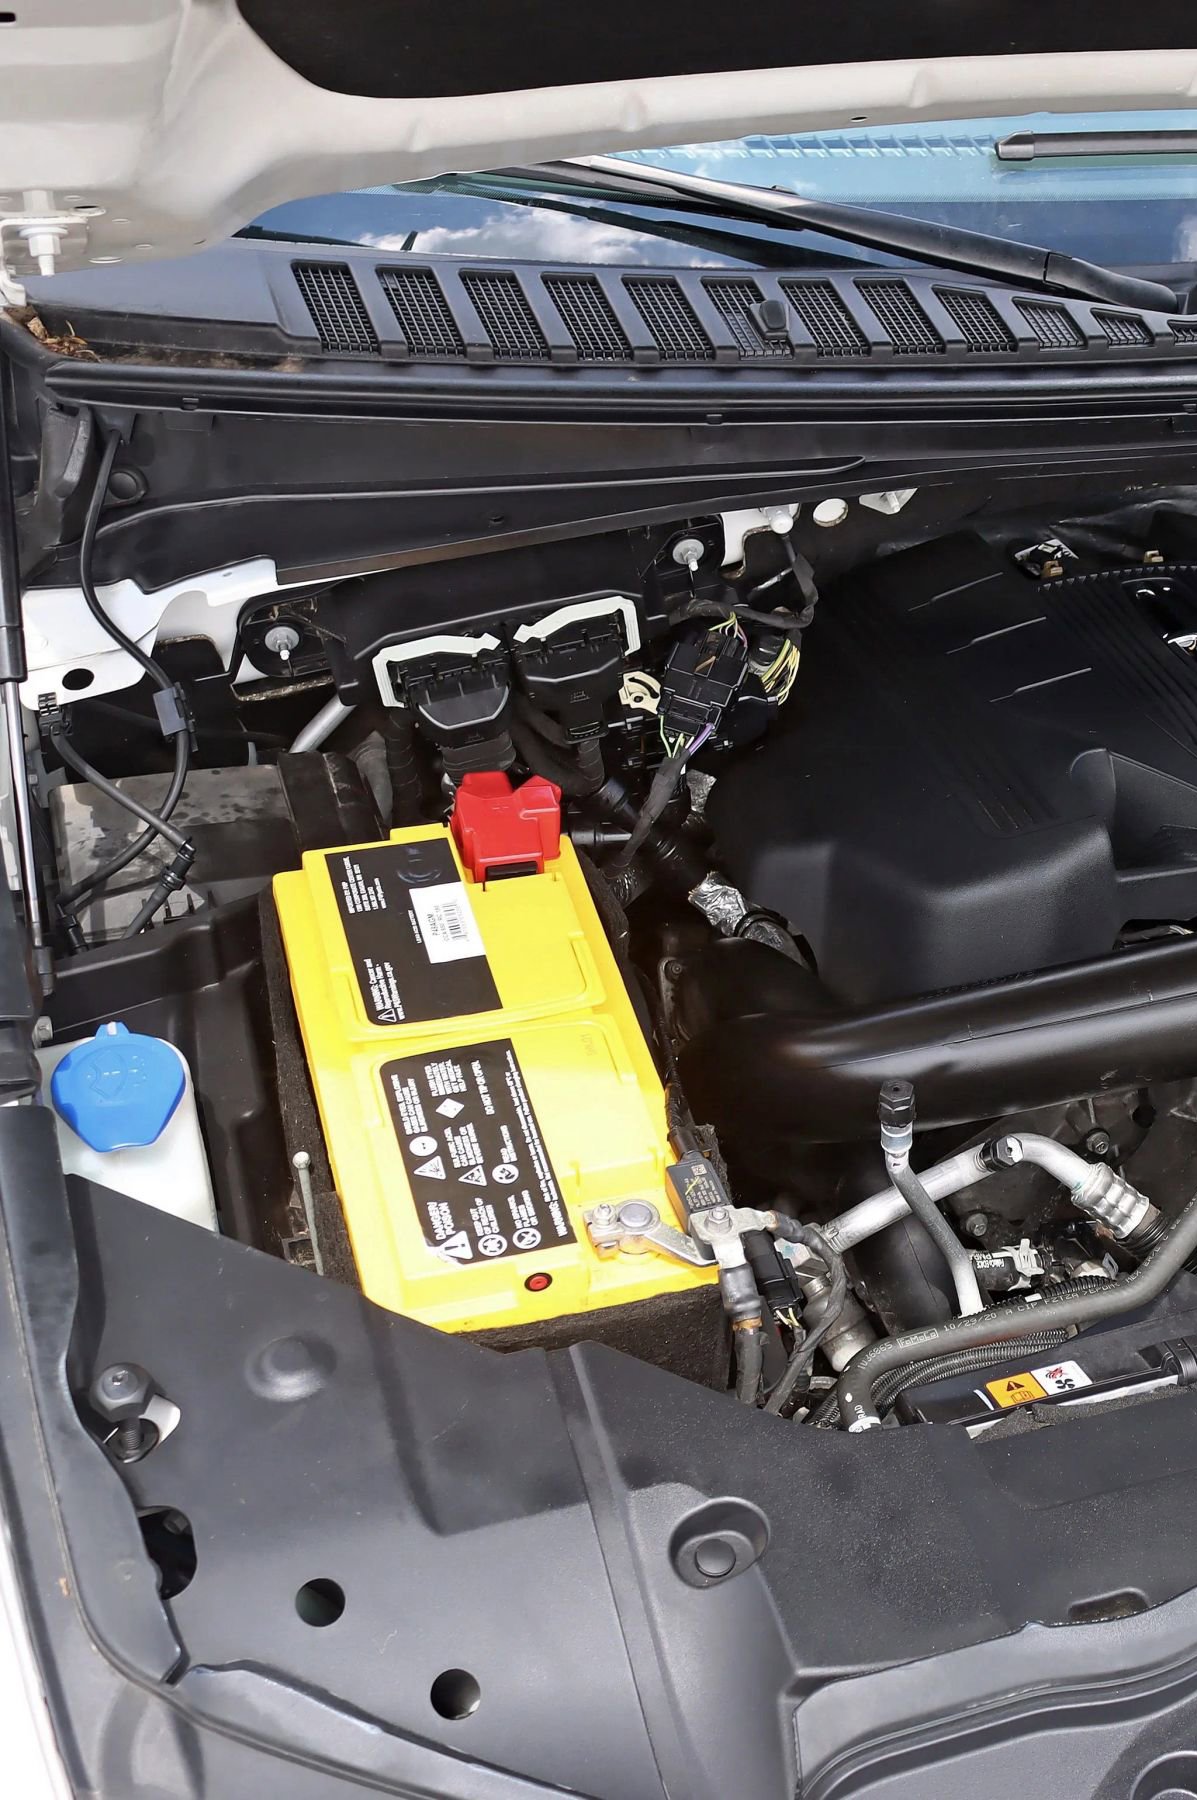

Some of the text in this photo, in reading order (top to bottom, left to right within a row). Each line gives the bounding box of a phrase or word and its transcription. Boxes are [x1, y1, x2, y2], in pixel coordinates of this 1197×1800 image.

[436, 1202, 456, 1235] POISON
[943, 1312, 998, 1332] 10/29/20
[857, 1404, 868, 1420] RAD
